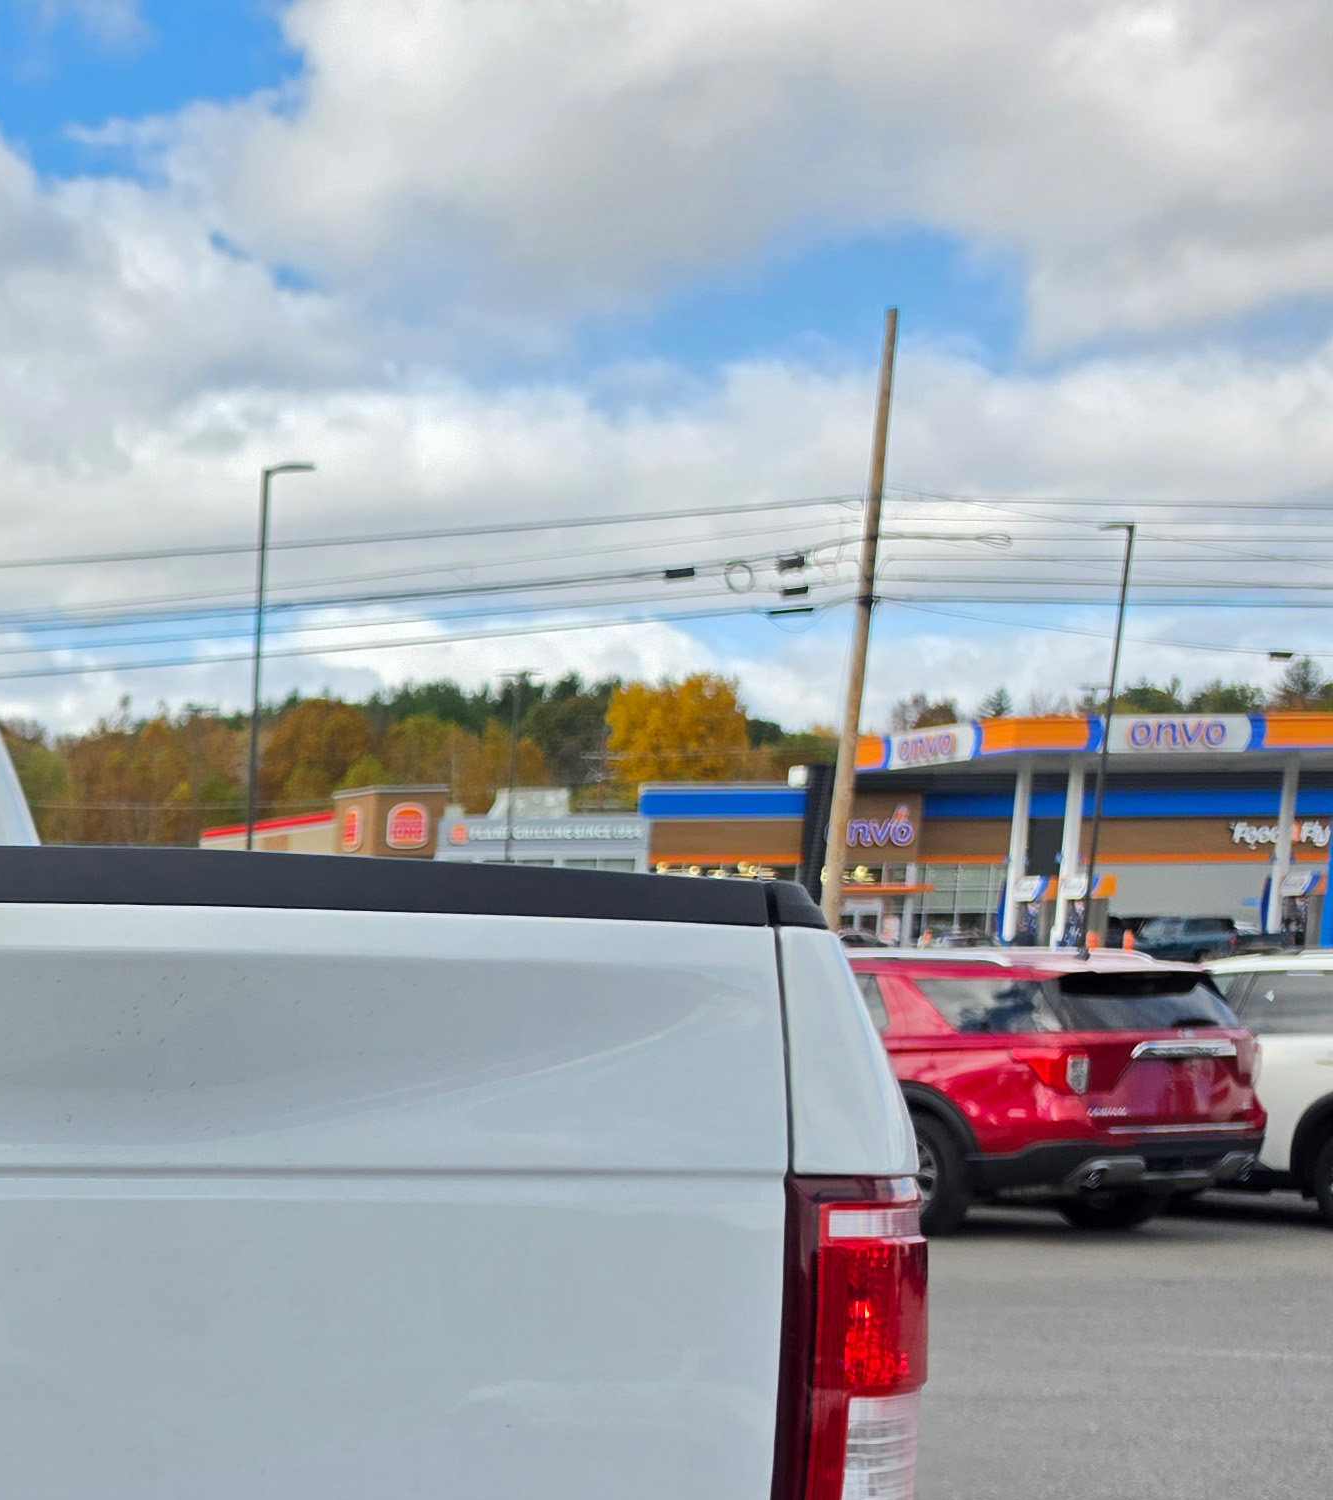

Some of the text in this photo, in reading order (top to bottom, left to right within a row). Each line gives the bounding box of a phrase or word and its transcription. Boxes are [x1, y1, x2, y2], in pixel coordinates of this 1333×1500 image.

[898, 732, 956, 762] onvo
[1128, 720, 1227, 747] onvo
[824, 819, 914, 846] nvo
